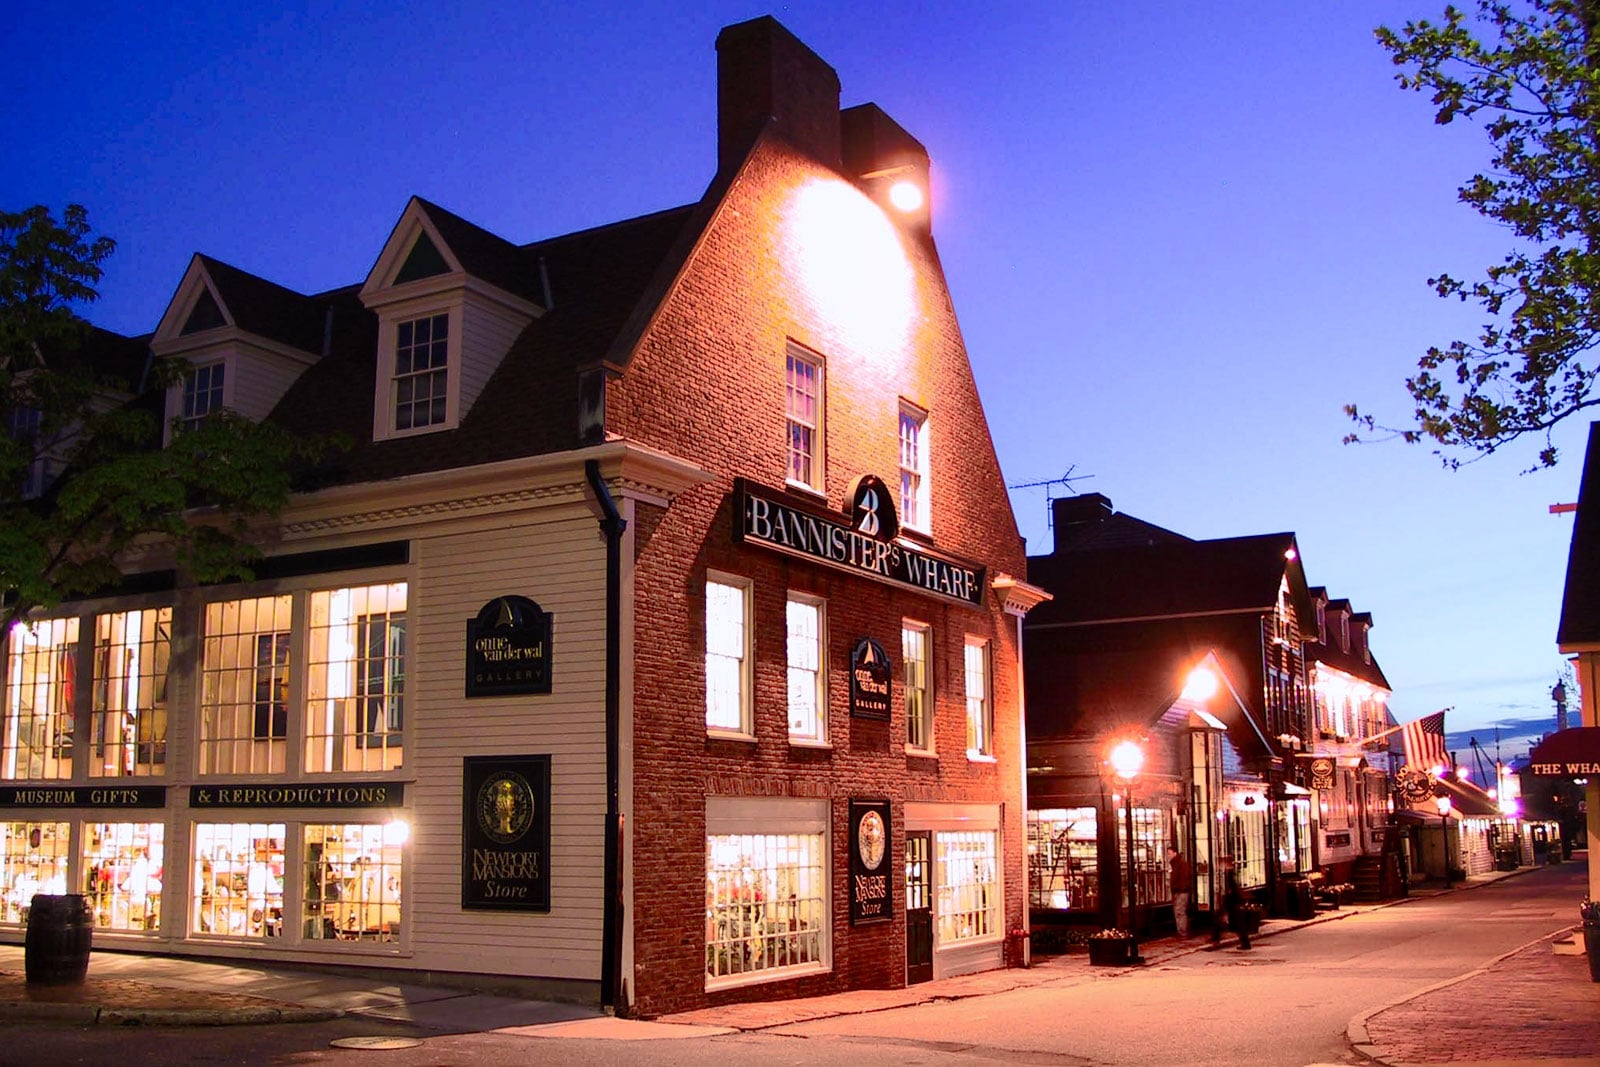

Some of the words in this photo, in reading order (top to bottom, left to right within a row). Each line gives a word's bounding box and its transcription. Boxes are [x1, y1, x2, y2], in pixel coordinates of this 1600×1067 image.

[904, 551, 975, 601] WHARF
[475, 636, 508, 651] onne
[504, 643, 522, 661] der
[523, 641, 542, 659] wal
[476, 669, 542, 683] GALLERY
[855, 699, 887, 711] GALLERY
[1532, 763, 1561, 775] THE
[15, 790, 76, 804] MUSEUM
[91, 790, 139, 804] GIFTS
[198, 789, 212, 804] &
[218, 787, 387, 804] REPRODUCTIONS
[473, 848, 540, 866] NEWPORT
[472, 862, 539, 881] MANSIONS
[484, 880, 528, 898] Store
[861, 901, 881, 916] Store
